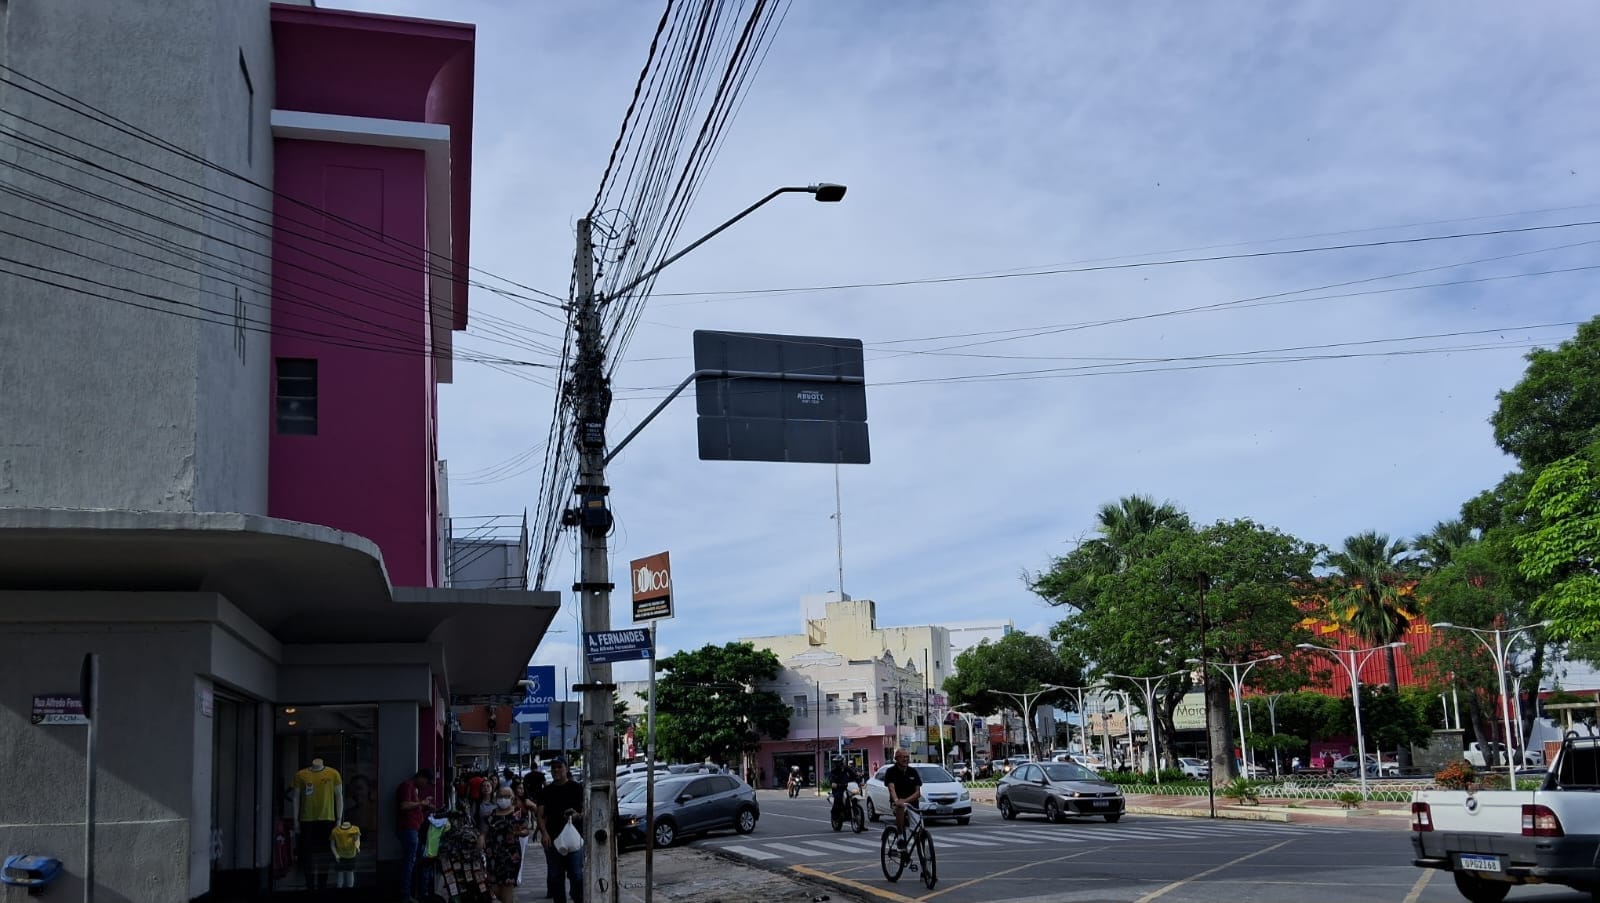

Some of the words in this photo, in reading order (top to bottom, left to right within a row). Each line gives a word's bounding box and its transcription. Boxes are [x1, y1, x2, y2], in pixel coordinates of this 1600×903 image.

[589, 634, 598, 647] A.
[598, 631, 645, 646] FERNANDES
[34, 698, 45, 707] Rua
[46, 698, 66, 707] Alfredo
